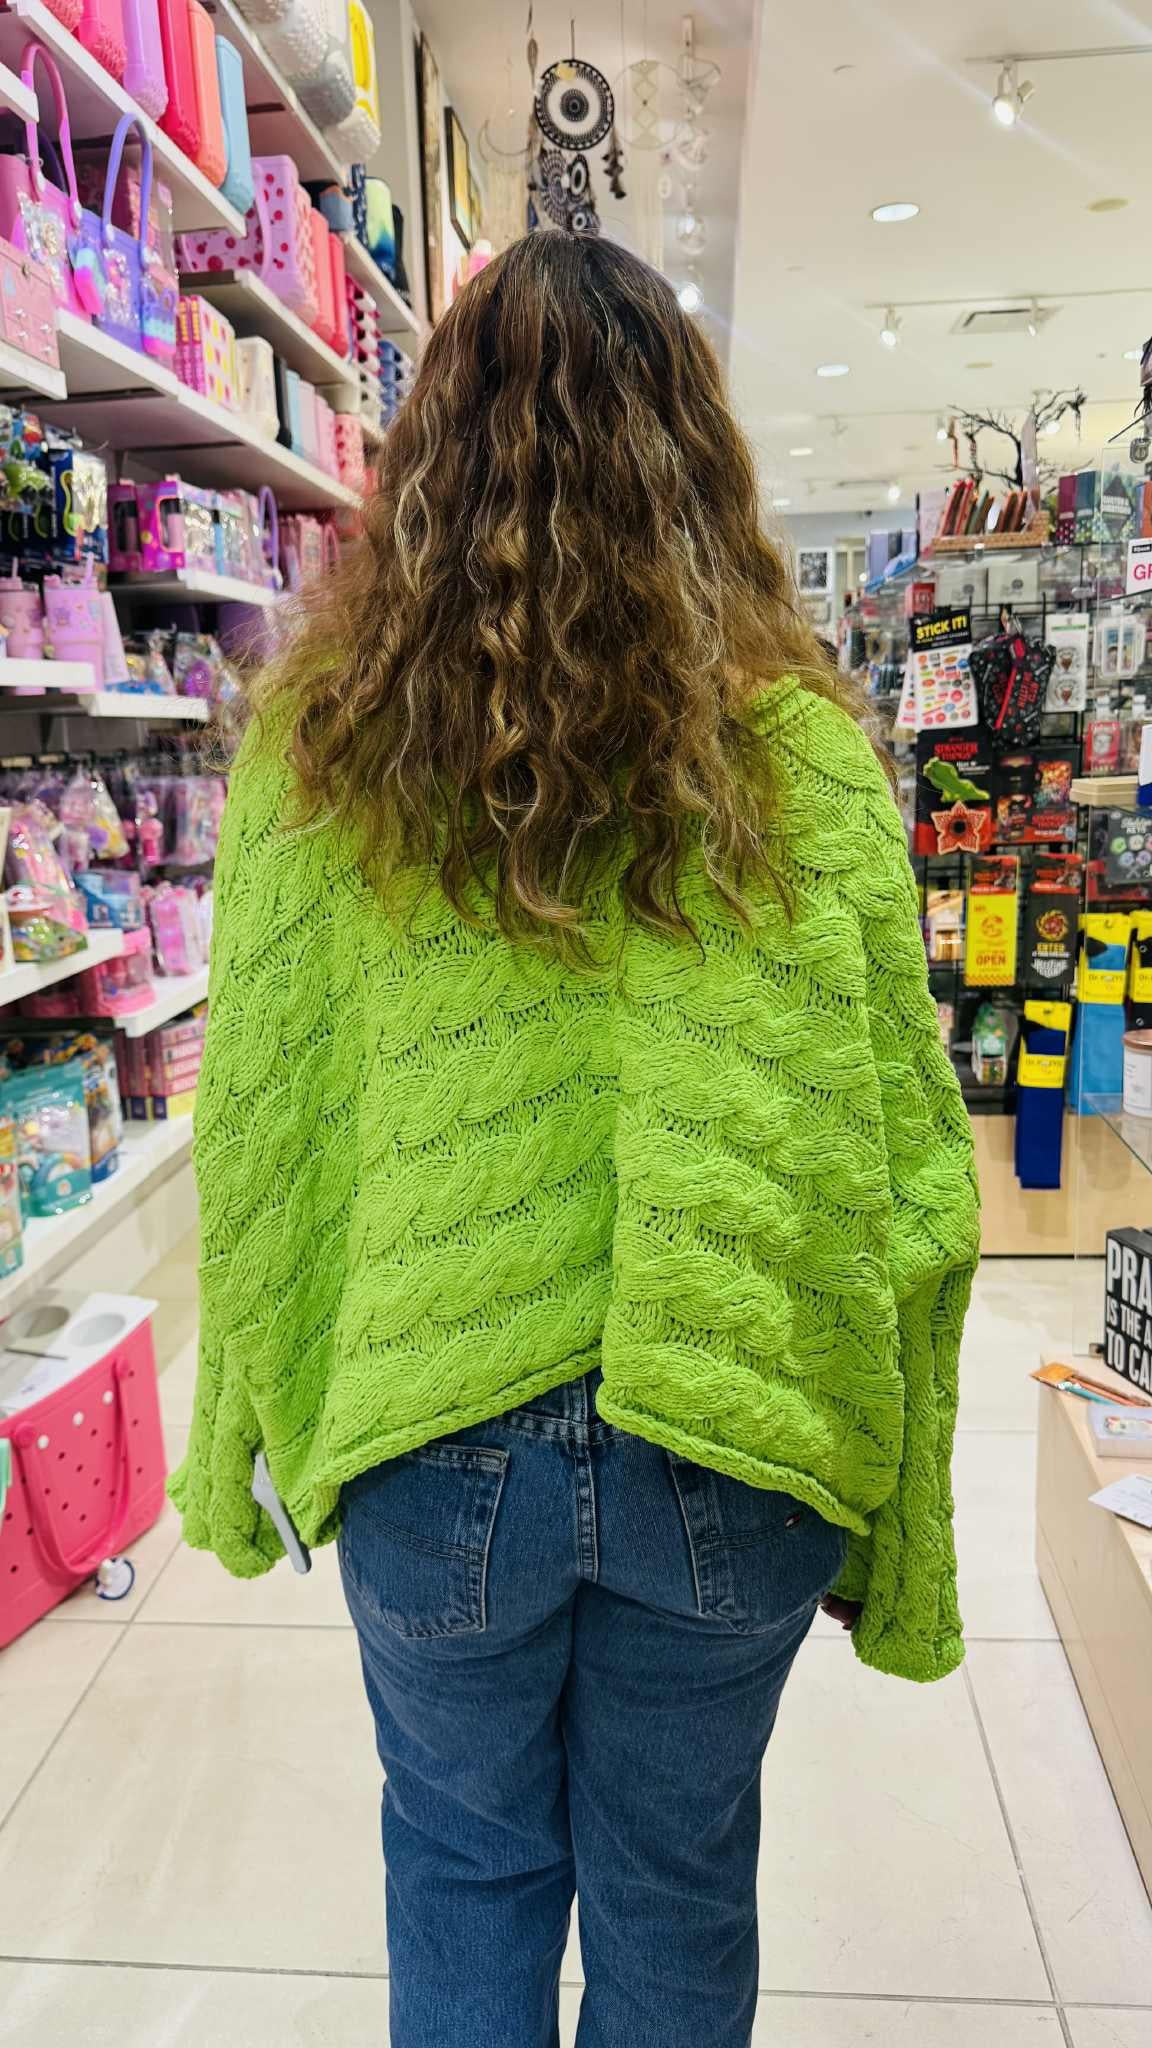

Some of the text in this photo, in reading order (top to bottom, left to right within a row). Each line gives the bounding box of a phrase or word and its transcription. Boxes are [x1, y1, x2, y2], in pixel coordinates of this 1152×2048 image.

[916, 620, 949, 640] STICK
[951, 615, 967, 630] IT!
[976, 954, 1006, 966] OPEN
[1106, 1295, 1118, 1326] IS
[1120, 1304, 1142, 1342] THE
[1106, 1328, 1152, 1393] TO CA
